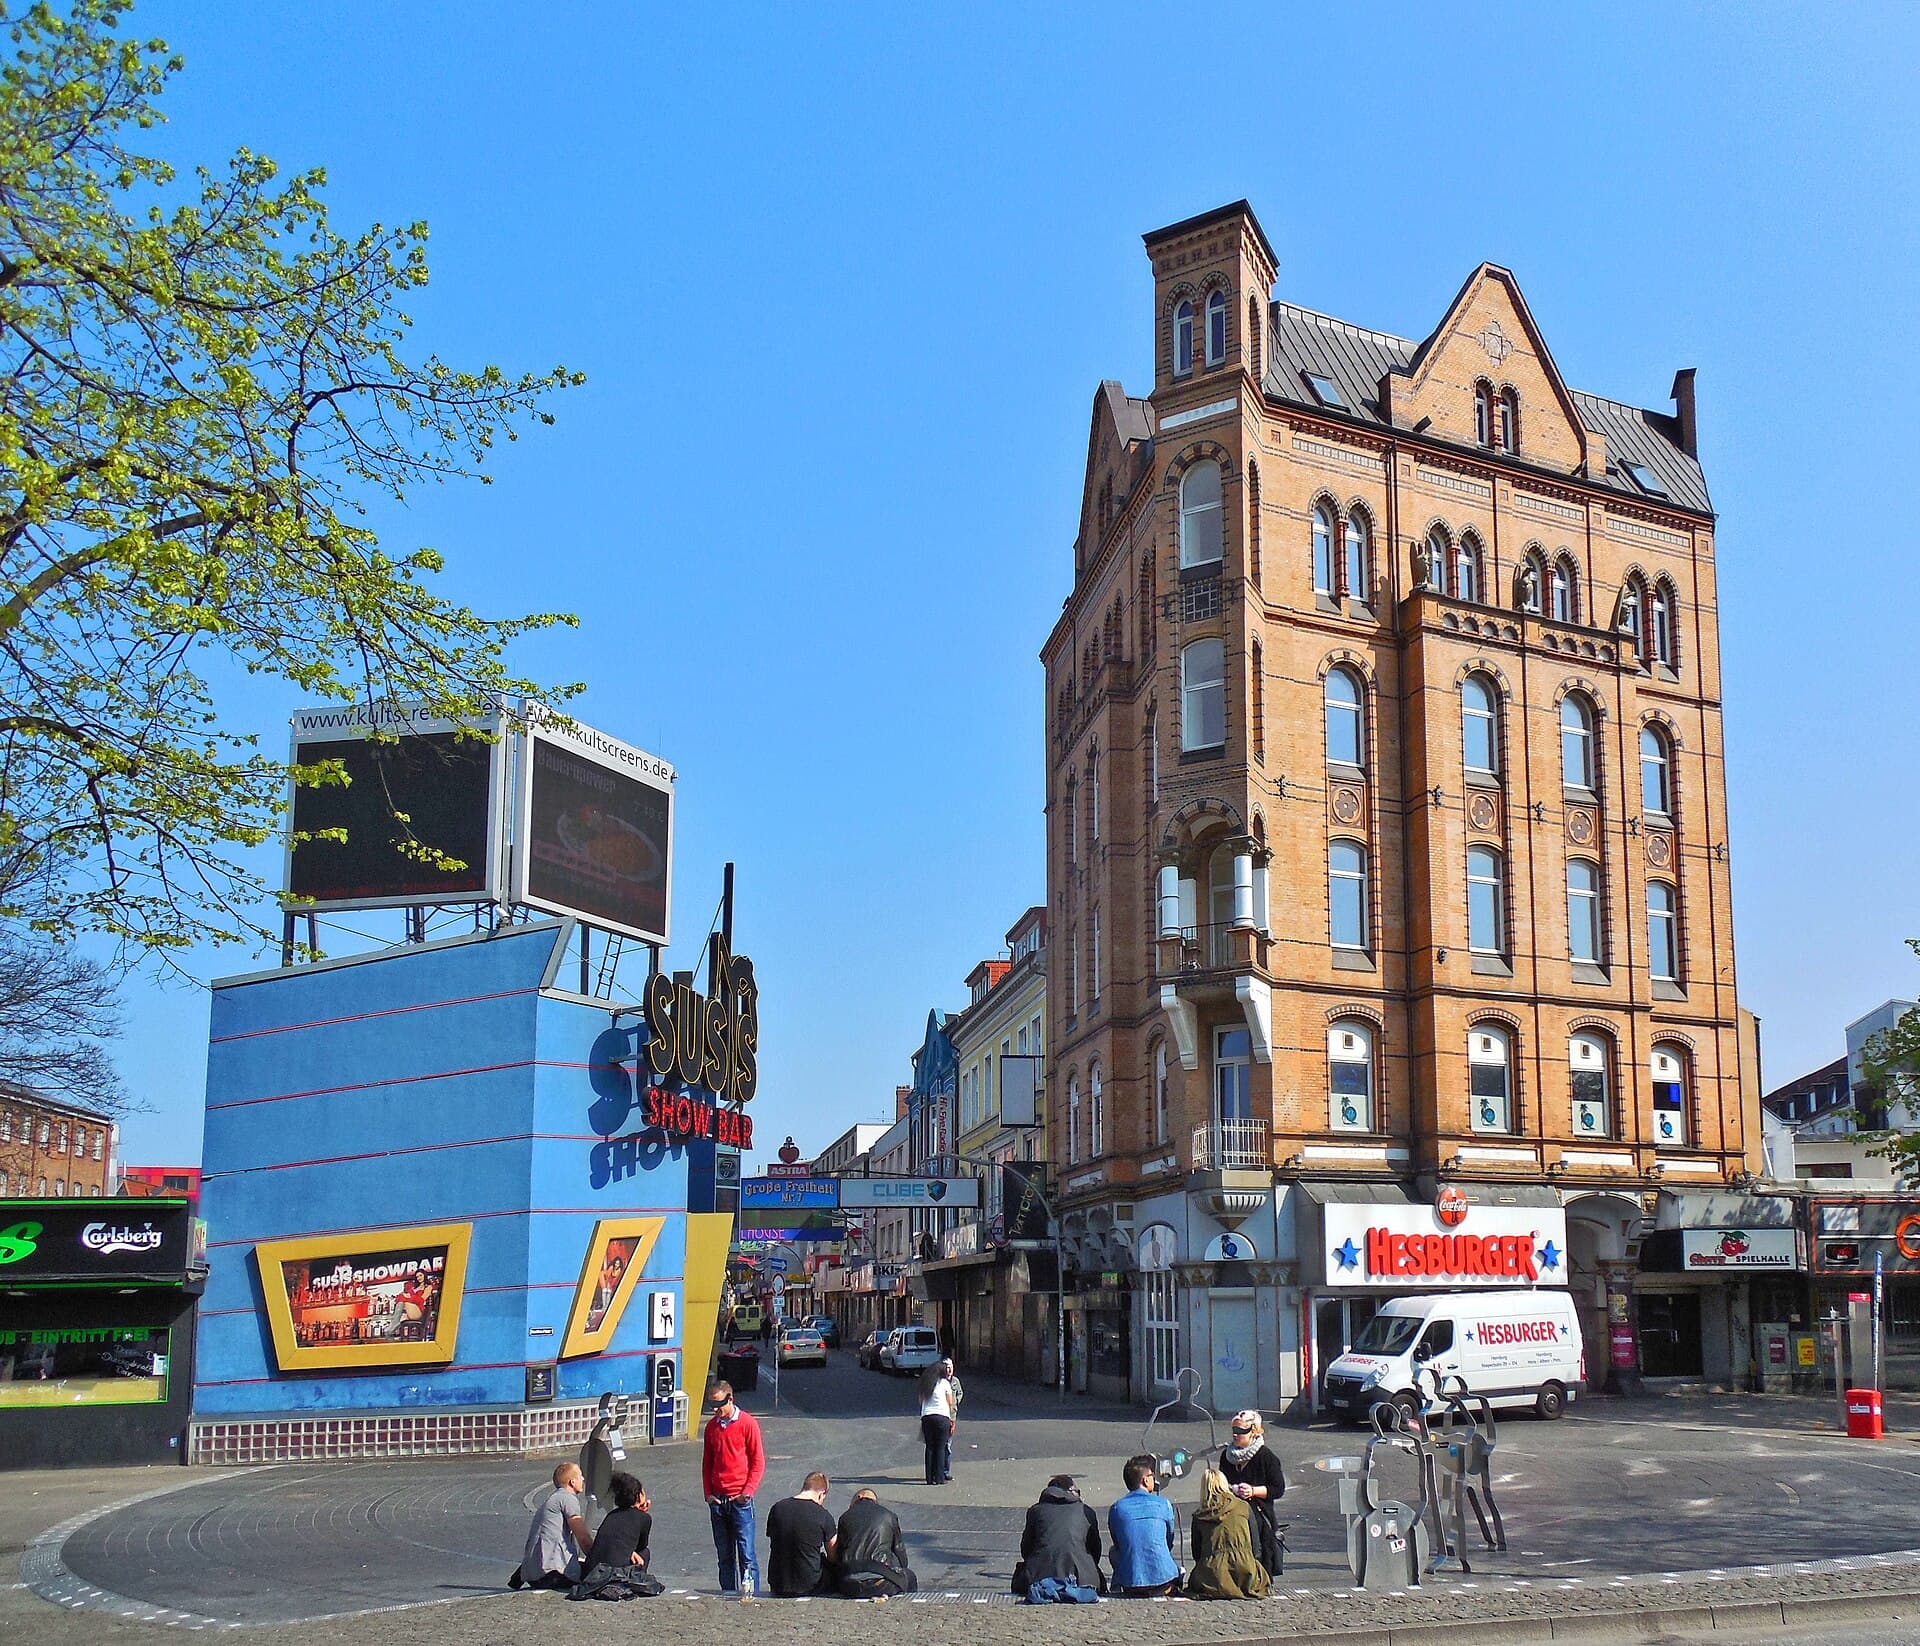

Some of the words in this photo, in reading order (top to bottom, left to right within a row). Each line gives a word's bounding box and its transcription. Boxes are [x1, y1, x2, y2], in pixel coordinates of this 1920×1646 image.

[301, 698, 492, 729] www.kultsre.e
[533, 707, 668, 780] ww.kultscreens.de
[648, 1085, 713, 1138] SHOW
[717, 1108, 753, 1150] BAR
[771, 1166, 807, 1175] ASTRA
[744, 1181, 782, 1197] Große
[785, 1180, 834, 1195] Freiheit
[872, 1183, 925, 1197] CUBE
[81, 1222, 163, 1249] Carlsberg
[1367, 1227, 1539, 1281] HESBURGER
[1736, 1255, 1791, 1263] SPIELHALLE
[31, 1328, 109, 1344] EINTRITT
[112, 1327, 149, 1342] FREI
[1477, 1320, 1559, 1345] HESBURGER
